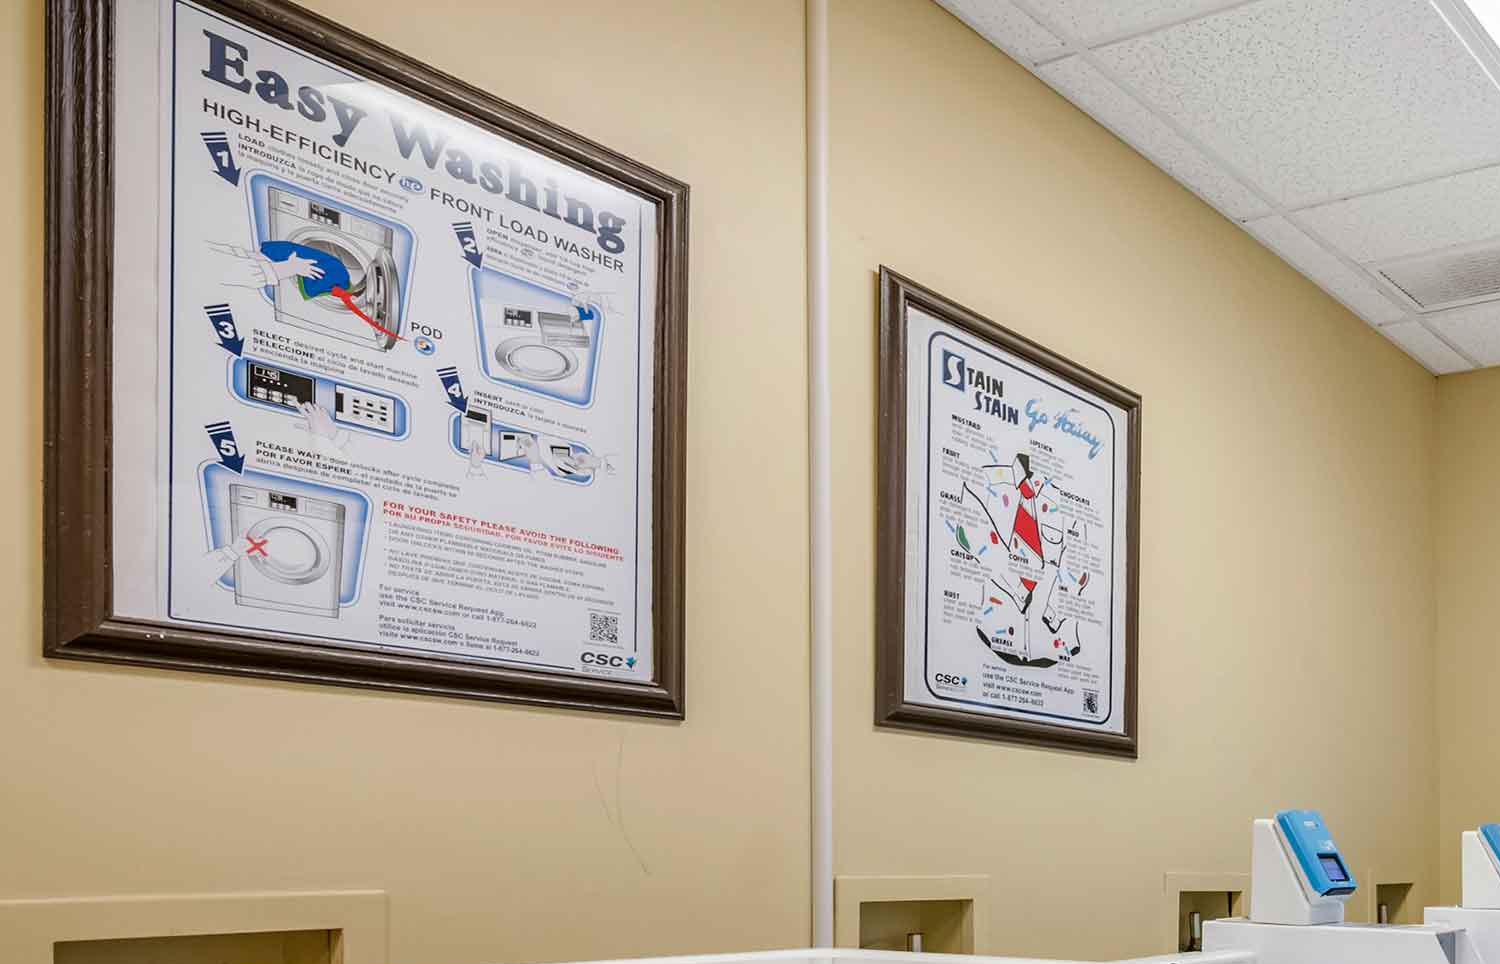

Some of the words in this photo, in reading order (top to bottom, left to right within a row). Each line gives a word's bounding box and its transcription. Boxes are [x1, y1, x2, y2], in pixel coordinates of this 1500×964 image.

[201, 28, 367, 146] Easy
[388, 106, 626, 254] Washing
[238, 132, 265, 148] LOAD
[216, 150, 229, 167] 1
[238, 142, 296, 169] INTRODUZCA
[203, 98, 396, 184] HIGH-EFFICIENCY
[430, 188, 494, 222] FRONT
[500, 214, 548, 244] LOAD
[553, 235, 624, 273] WASHER
[486, 228, 509, 241] OPEN
[463, 237, 477, 253] 2
[218, 320, 234, 339] 3
[410, 322, 442, 340] POD
[253, 328, 290, 344] SELECT
[294, 340, 323, 354] desired
[253, 336, 314, 359] SELECCIONE
[447, 383, 461, 397] 4
[474, 389, 502, 402] INSERT
[474, 397, 525, 416] INTRODUZCA
[951, 414, 982, 430] MUSTARD
[973, 389, 1019, 426] STAIN
[1023, 398, 1048, 433] Go
[1053, 411, 1104, 459] Away
[219, 439, 235, 456] 5
[256, 439, 294, 454] PLEASE
[297, 448, 320, 460] WAIT
[942, 446, 960, 460] FRUIT
[256, 448, 276, 459] POR
[279, 453, 312, 466] FAVOR
[316, 460, 352, 475] ESPERE
[939, 490, 961, 503] GRASS
[384, 501, 404, 512] FOR
[409, 506, 437, 518] YOUR
[439, 512, 476, 526] SAFETY
[480, 520, 516, 534] PLEASE
[519, 528, 546, 541] AVOID
[550, 534, 566, 545] THE
[384, 508, 401, 519] POR
[419, 515, 452, 528] PROPIA
[523, 536, 546, 547] FAVOR
[1008, 553, 1029, 564] COFFEE
[393, 585, 419, 595] service
[943, 590, 959, 599] RUST
[379, 599, 395, 607] visit
[379, 591, 392, 599] use
[395, 593, 407, 602] the
[410, 596, 426, 605] CSC
[429, 599, 456, 609] Service
[458, 603, 488, 615] Request
[490, 608, 504, 617] App
[378, 614, 395, 622] Para
[397, 616, 425, 626] solicitar
[427, 621, 454, 630] servicio
[378, 629, 398, 637] visite
[378, 621, 400, 630] utilice
[448, 631, 462, 639] CSC
[465, 633, 488, 643] Service
[491, 637, 518, 647] Request
[991, 636, 1012, 647] GREASE
[580, 651, 624, 667] CSC
[935, 672, 959, 685] CSC
[994, 673, 1003, 681] the
[1005, 675, 1017, 684] CSC
[1019, 678, 1039, 688] Service
[1040, 682, 1061, 692] Request
